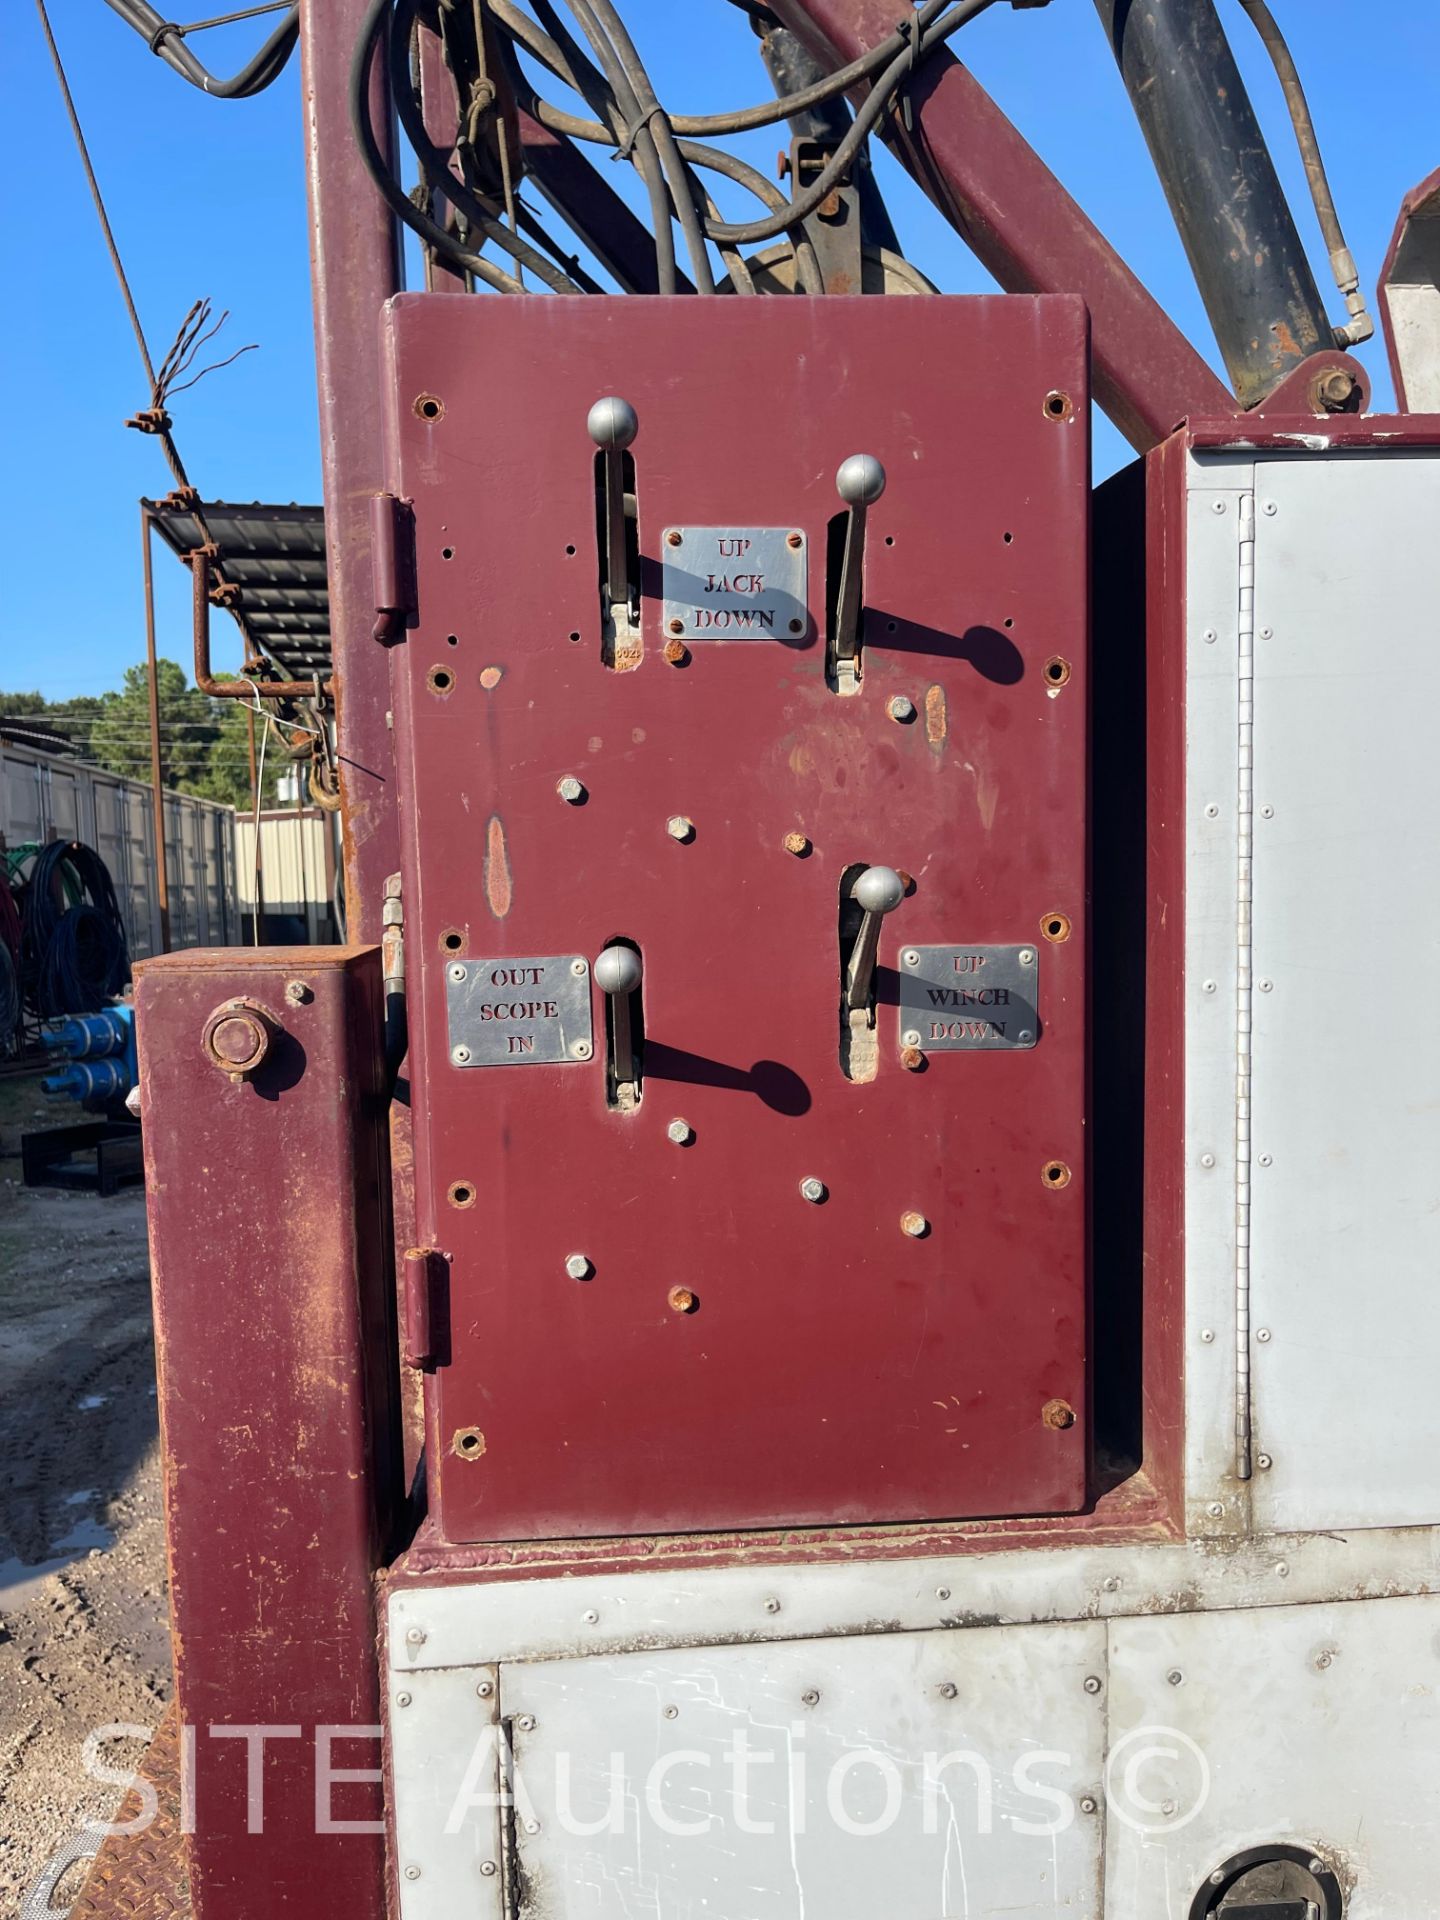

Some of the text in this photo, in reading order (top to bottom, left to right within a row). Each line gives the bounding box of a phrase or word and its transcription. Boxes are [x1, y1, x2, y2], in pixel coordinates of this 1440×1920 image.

[717, 539, 752, 557] UP
[704, 574, 766, 593] JACK
[694, 609, 776, 629] DOWN
[952, 956, 986, 974] UP
[490, 967, 545, 987] OUT
[926, 988, 1010, 1006] WINCH
[480, 1001, 559, 1022] SCOPE
[928, 1021, 1008, 1040] DOWN
[506, 1035, 535, 1054] IN
